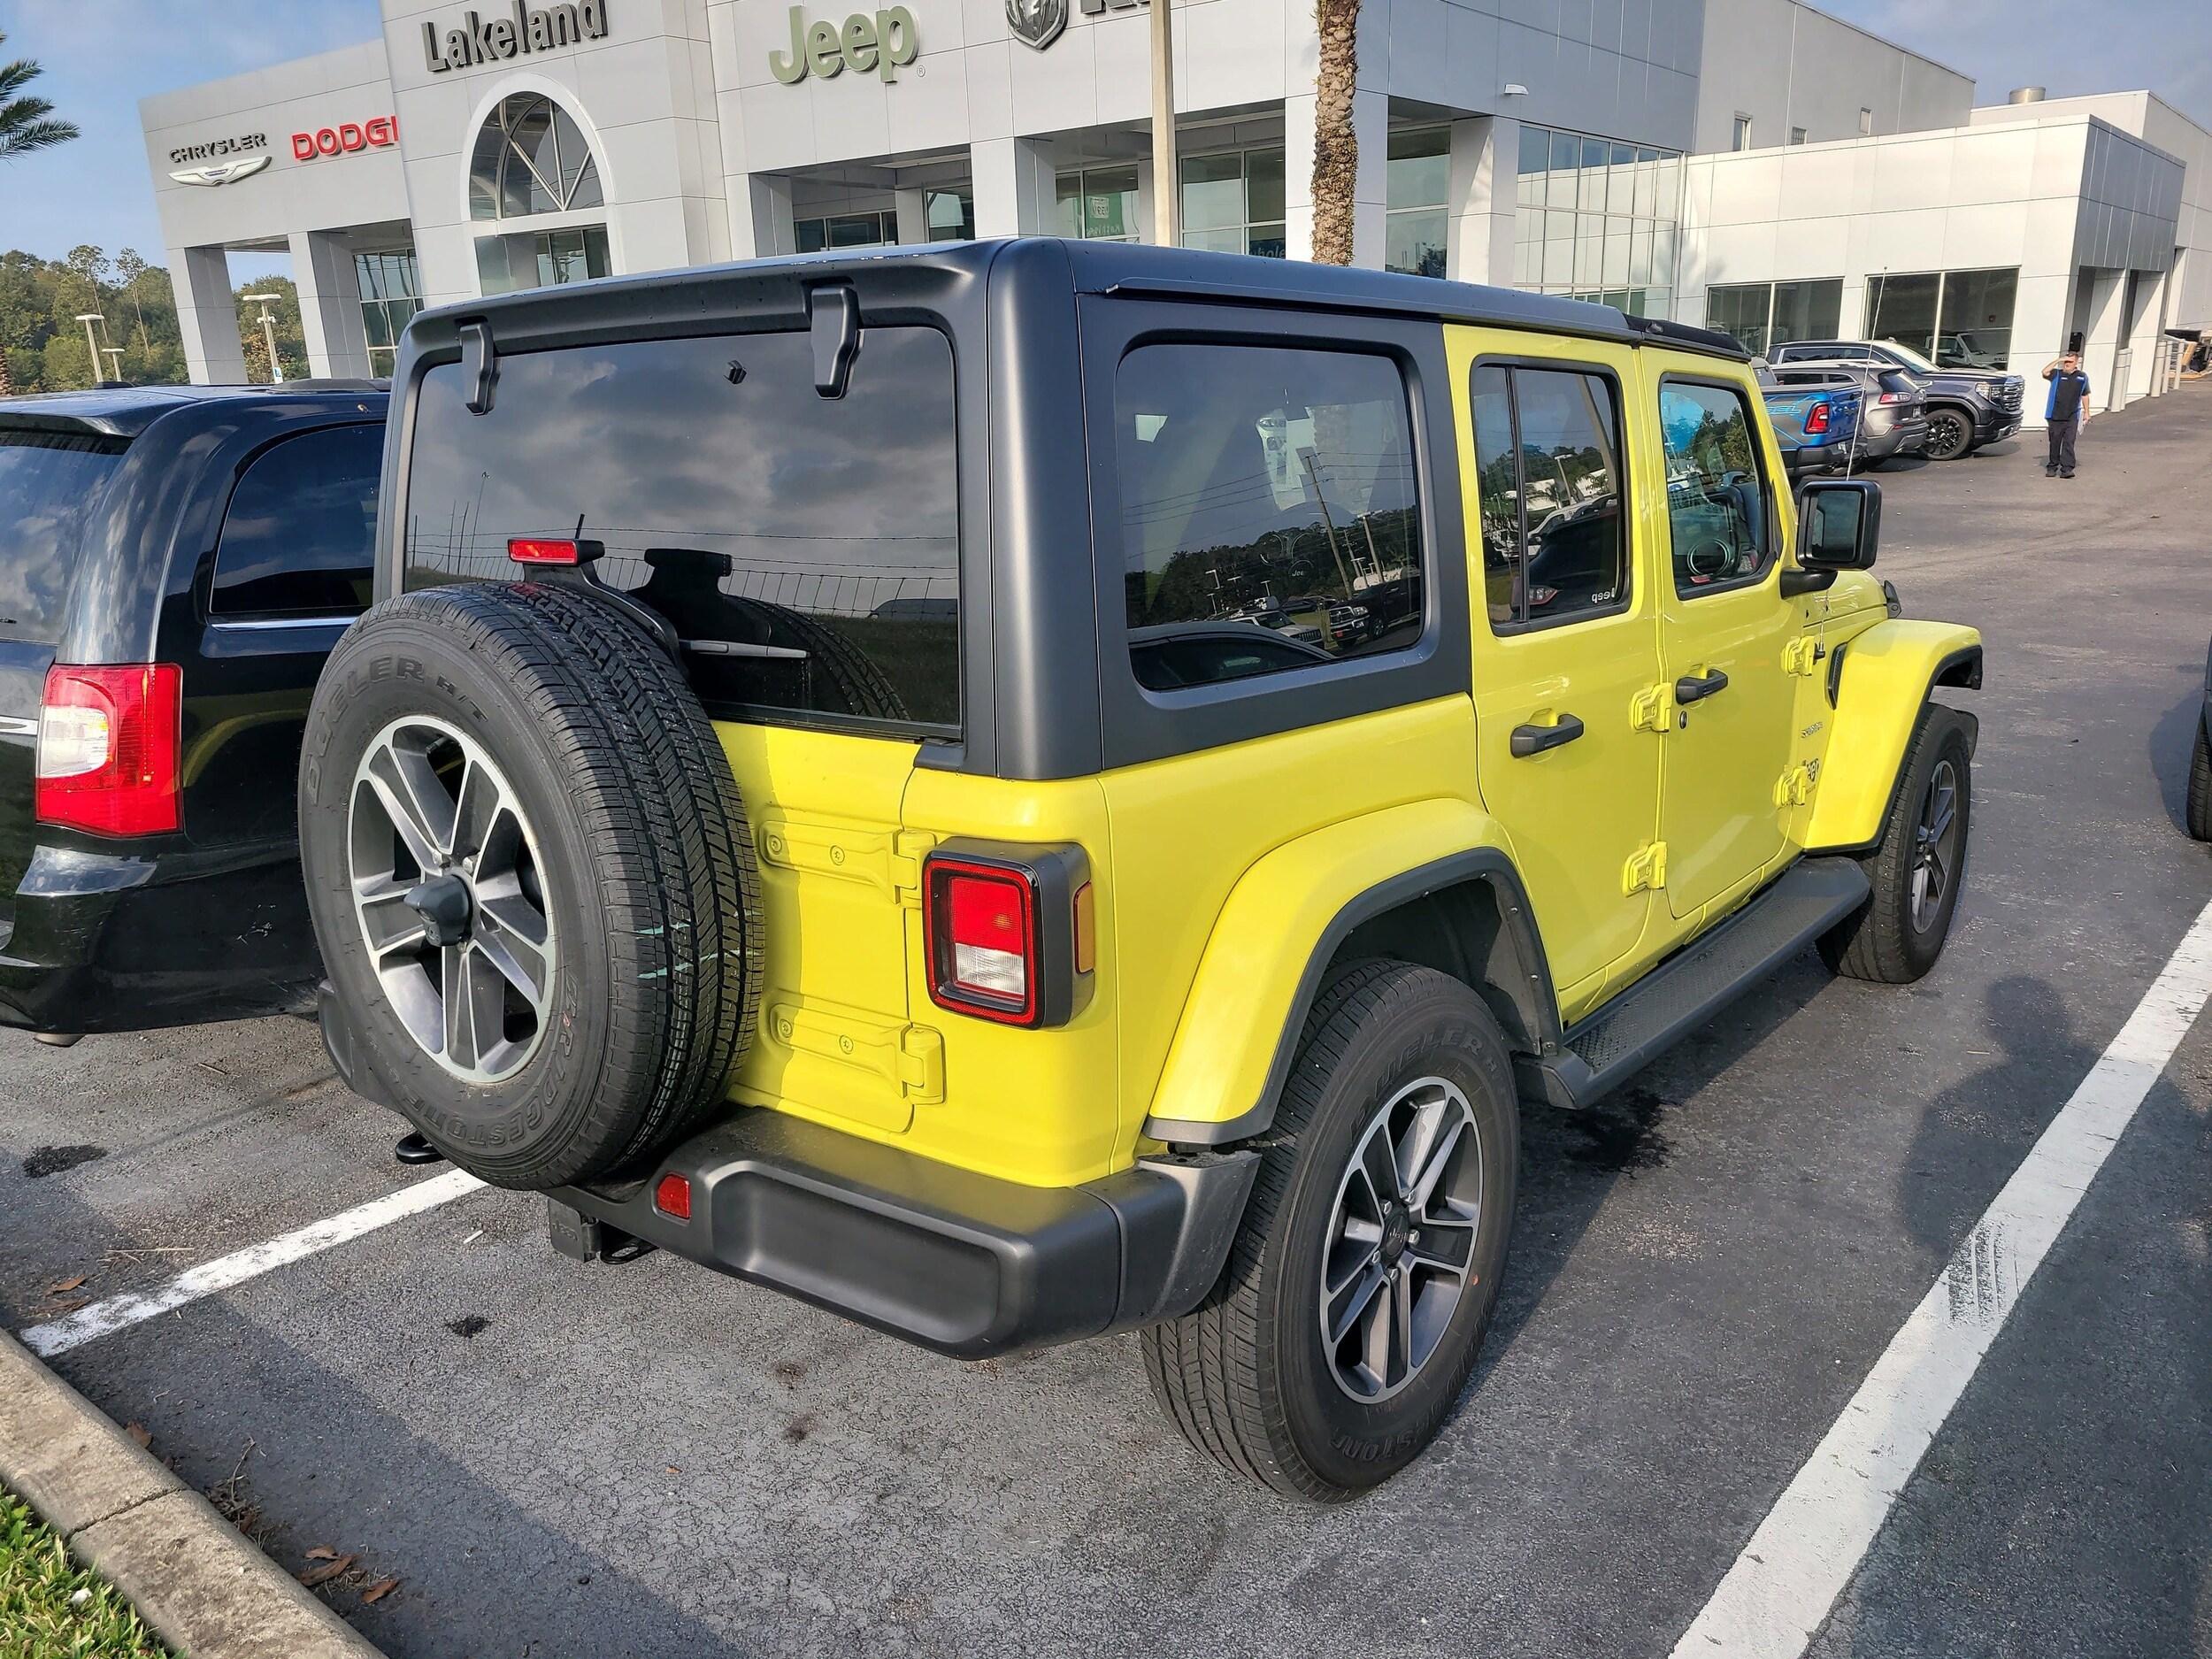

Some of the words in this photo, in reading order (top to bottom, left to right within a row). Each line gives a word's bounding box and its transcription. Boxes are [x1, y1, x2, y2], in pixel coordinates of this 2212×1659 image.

[420, 0, 608, 73] Lakeland
[769, 5, 919, 84] Jeep
[169, 133, 267, 163] CHRYSLER
